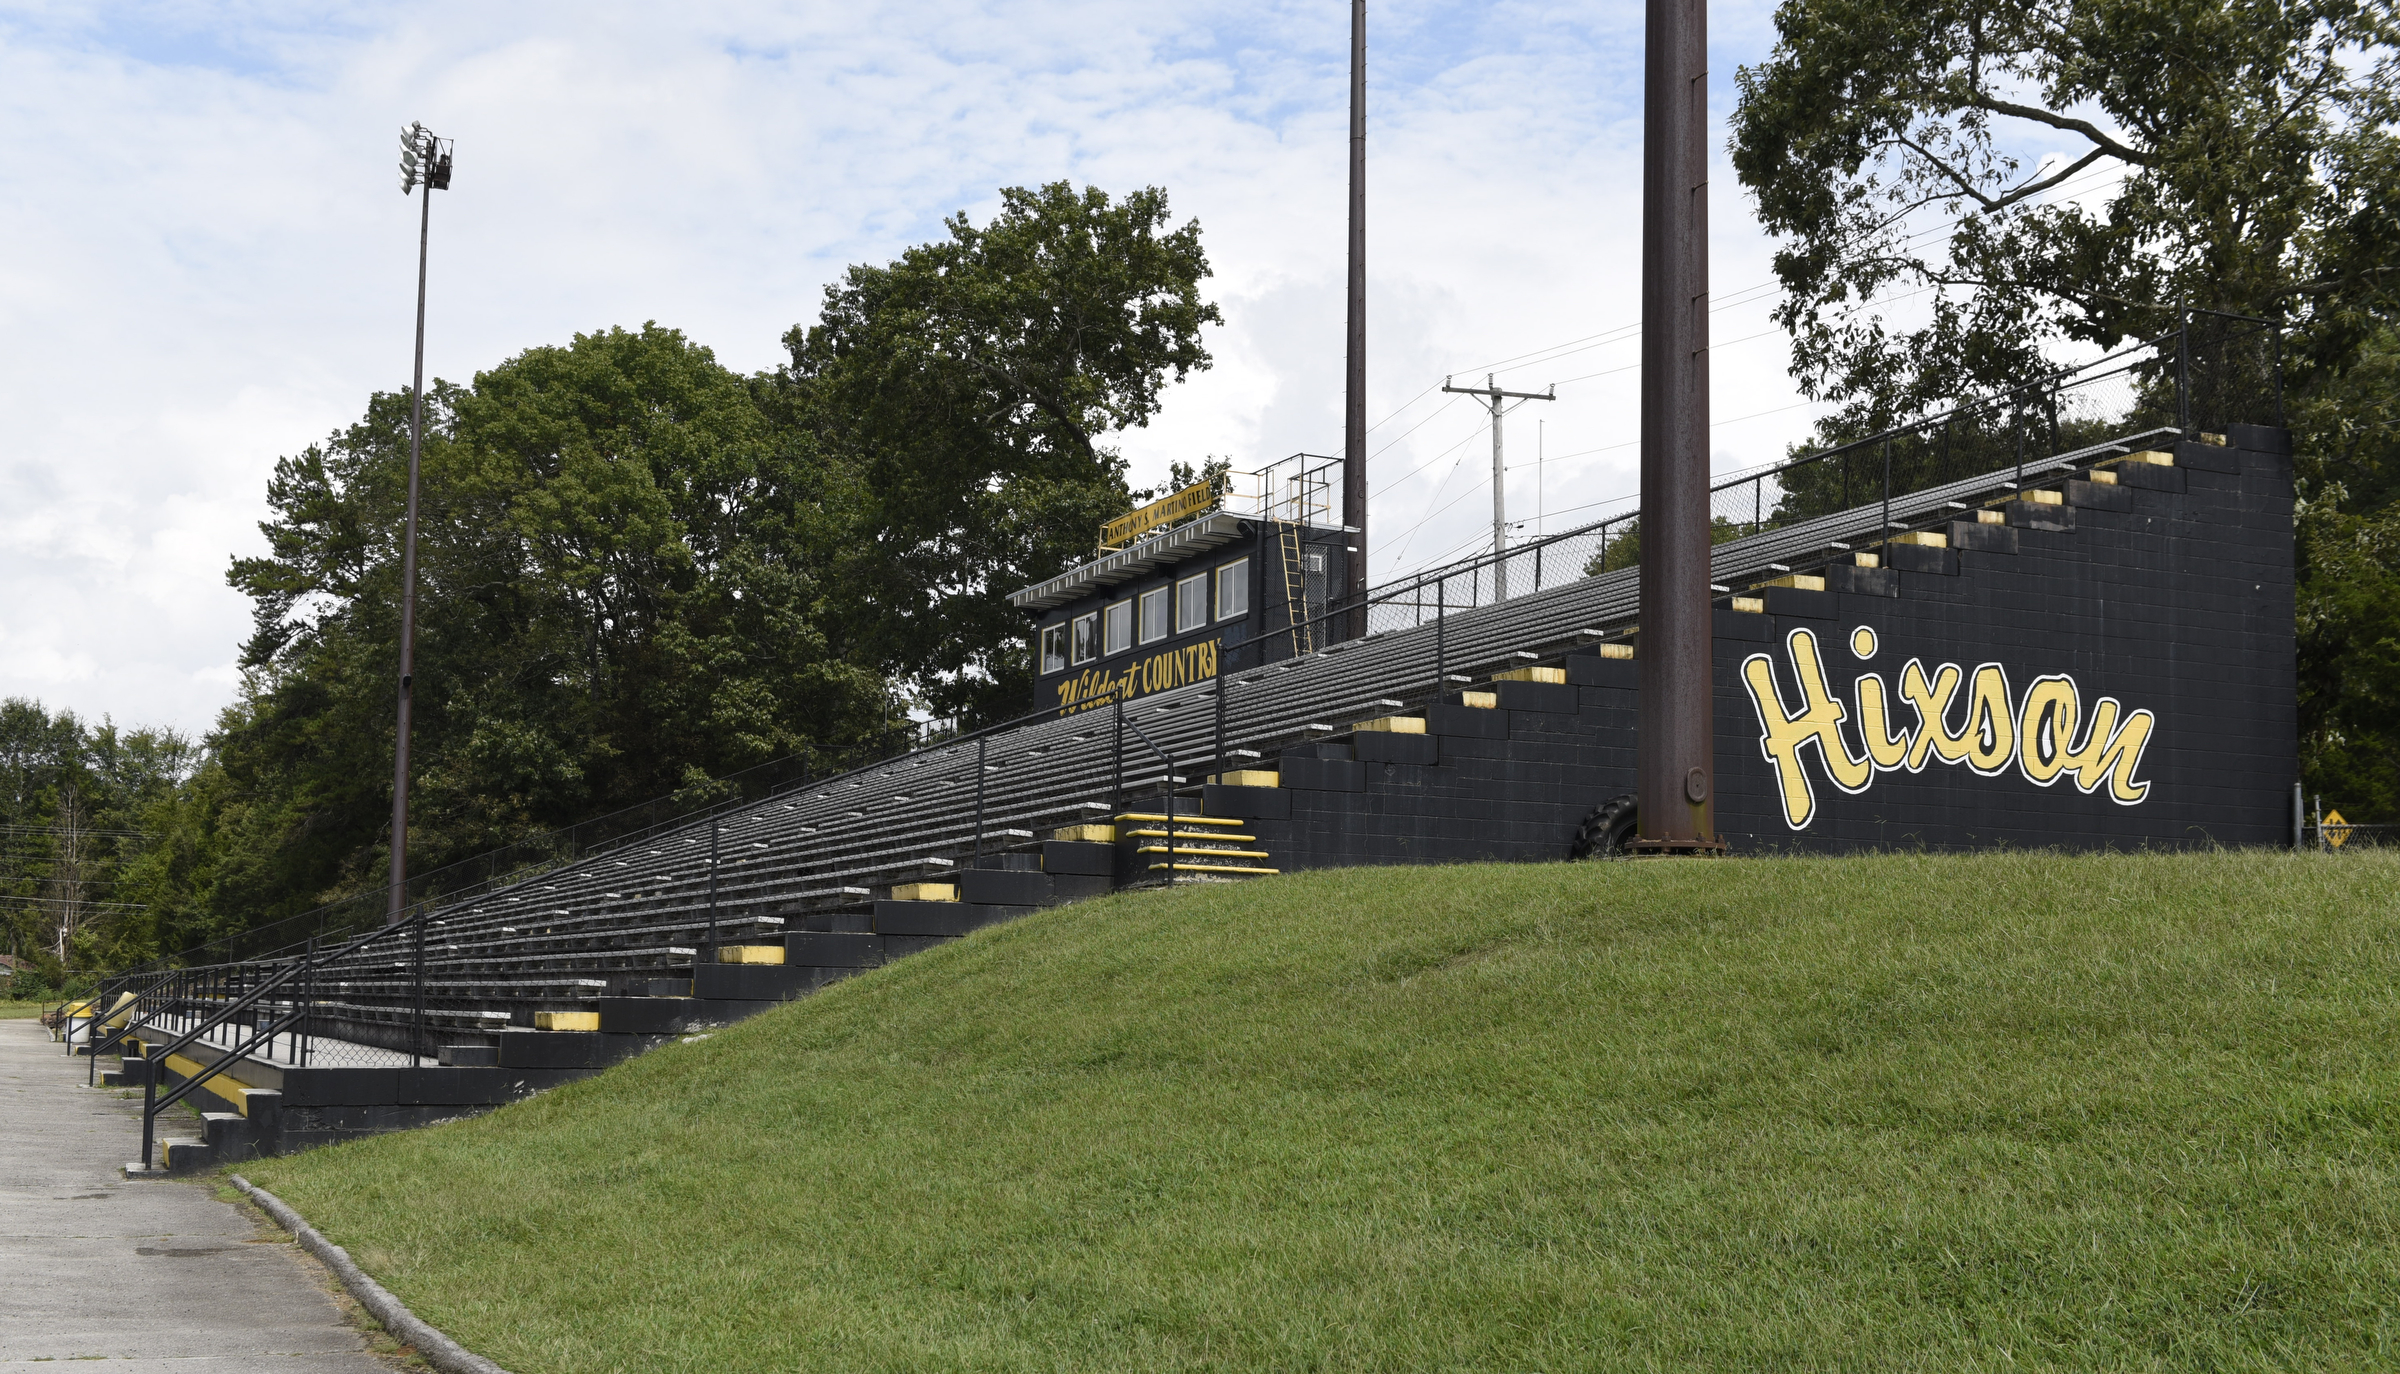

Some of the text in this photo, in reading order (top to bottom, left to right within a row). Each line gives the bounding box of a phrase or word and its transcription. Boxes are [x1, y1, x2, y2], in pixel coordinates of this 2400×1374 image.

[1108, 514, 1143, 541] ANTHONY
[1152, 497, 1187, 521] MARTINO
[1187, 486, 1211, 507] FIELD
[1058, 637, 1221, 717] Wildcat COUNTRY
[1740, 625, 2155, 830] Hixson
